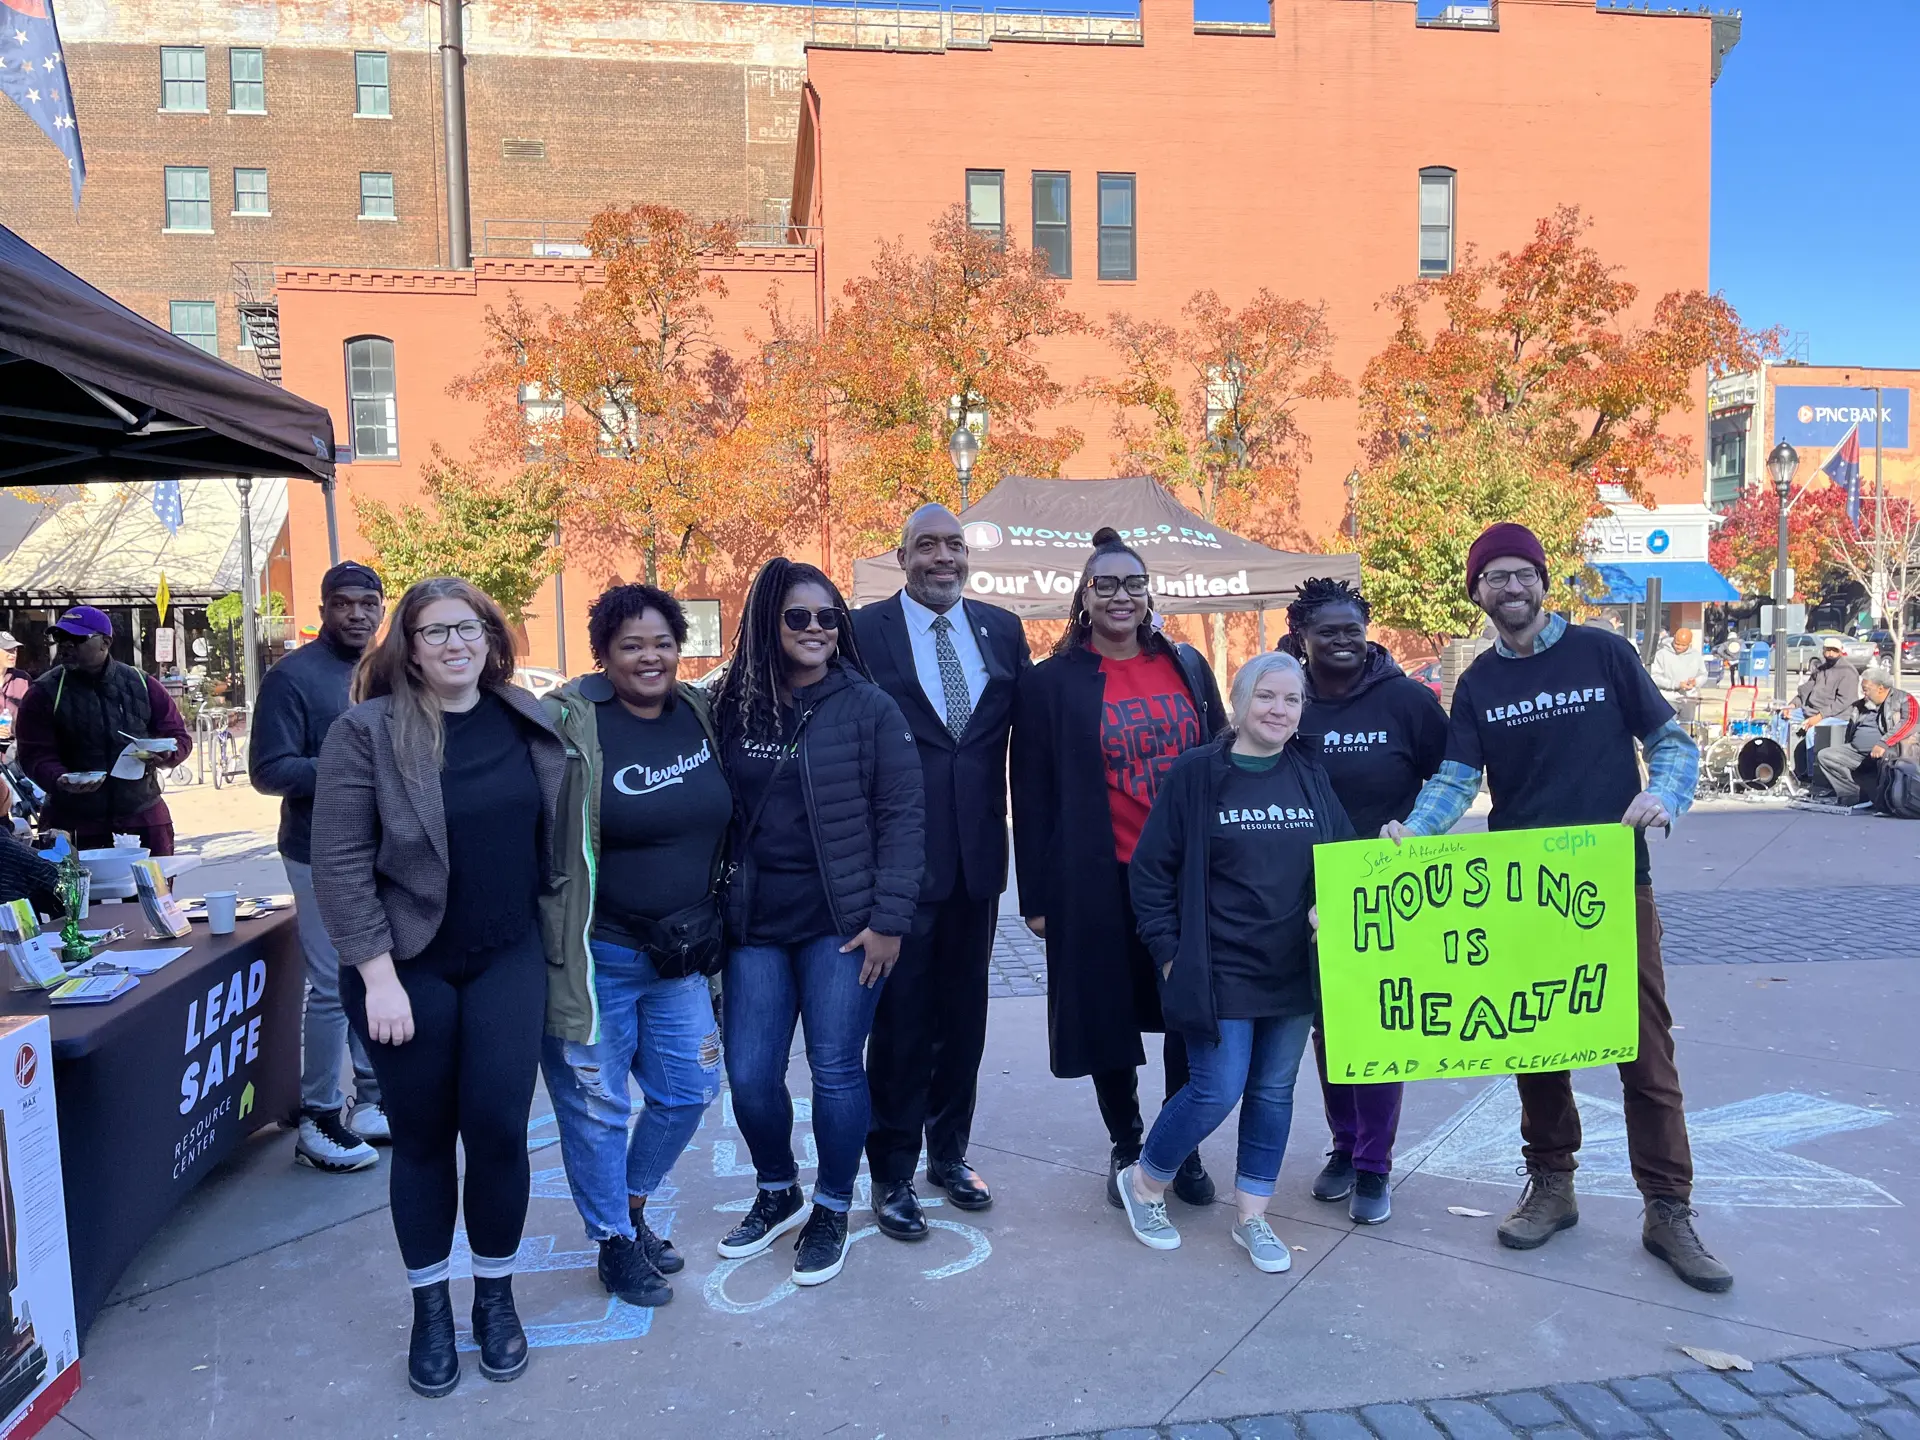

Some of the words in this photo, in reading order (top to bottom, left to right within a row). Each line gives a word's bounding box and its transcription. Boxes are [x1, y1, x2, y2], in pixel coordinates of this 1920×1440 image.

[1008, 526, 1093, 541] WOVU
[1180, 527, 1217, 542] FM
[1011, 538, 1047, 547] BBC
[1167, 535, 1222, 549] RADIO
[970, 571, 1029, 595] Our
[1033, 570, 1082, 595] Voi
[1147, 570, 1250, 597] United
[1101, 692, 1197, 729] DELTA
[1485, 701, 1535, 723] LEAD
[1555, 688, 1606, 706] SAFE
[1506, 712, 1549, 727] RESOURCE
[1552, 705, 1586, 716] CENTER
[1343, 731, 1388, 744] SAFE
[612, 738, 711, 795] Cleveland
[1218, 808, 1266, 825] LEAD
[1408, 843, 1467, 859] Affordable
[1543, 830, 1597, 856] cdph
[1353, 858, 1606, 952] HOUSING
[1443, 928, 1489, 965] IS
[184, 959, 267, 1056] LEAD
[1379, 963, 1607, 1041] HEALTH
[179, 1014, 262, 1115] SAFE
[1345, 1059, 1420, 1078] LEAD
[1435, 1057, 1493, 1073] SAFE
[1504, 1050, 1597, 1070] CLEVELAND
[1602, 1046, 1635, 1060] 2022
[22, 1096, 36, 1110] MAX
[174, 1095, 232, 1160] RESOURCE
[172, 1128, 217, 1180] CENTER
